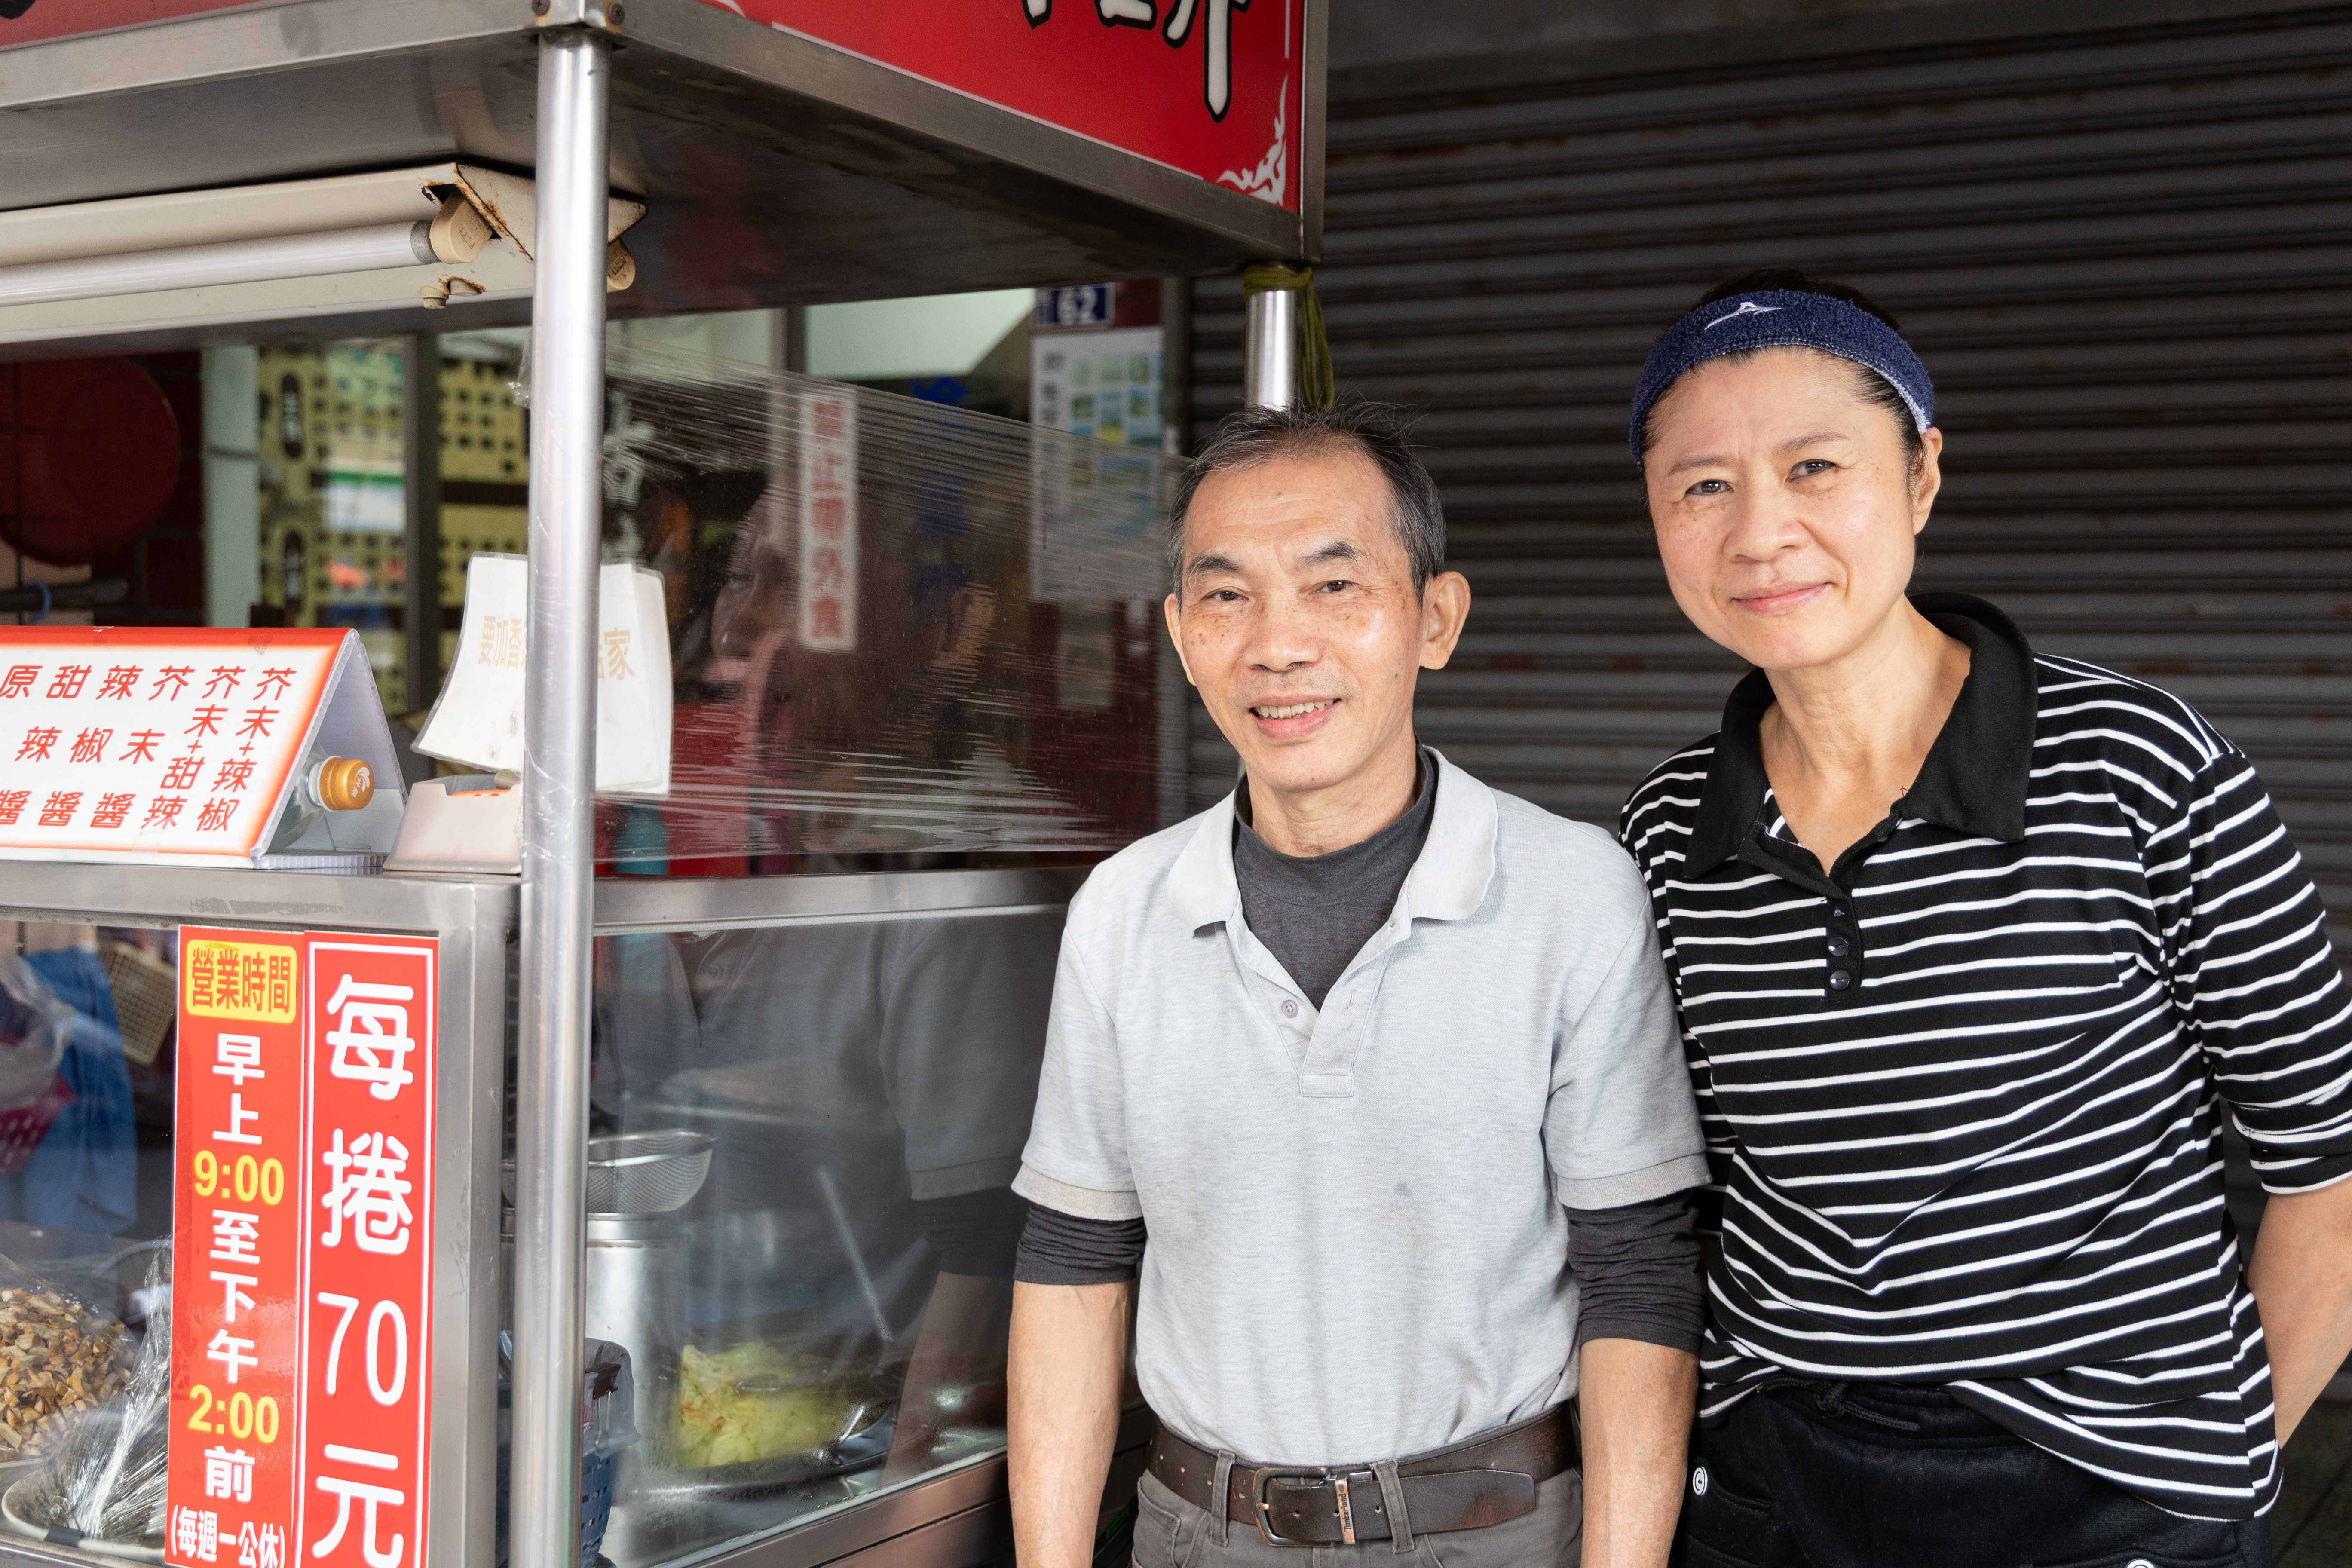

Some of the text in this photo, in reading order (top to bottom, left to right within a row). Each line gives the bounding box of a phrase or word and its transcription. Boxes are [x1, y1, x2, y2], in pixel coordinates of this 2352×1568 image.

[191, 946, 292, 1014] 營業時間
[1338, 1493, 1351, 1532] Timberland
